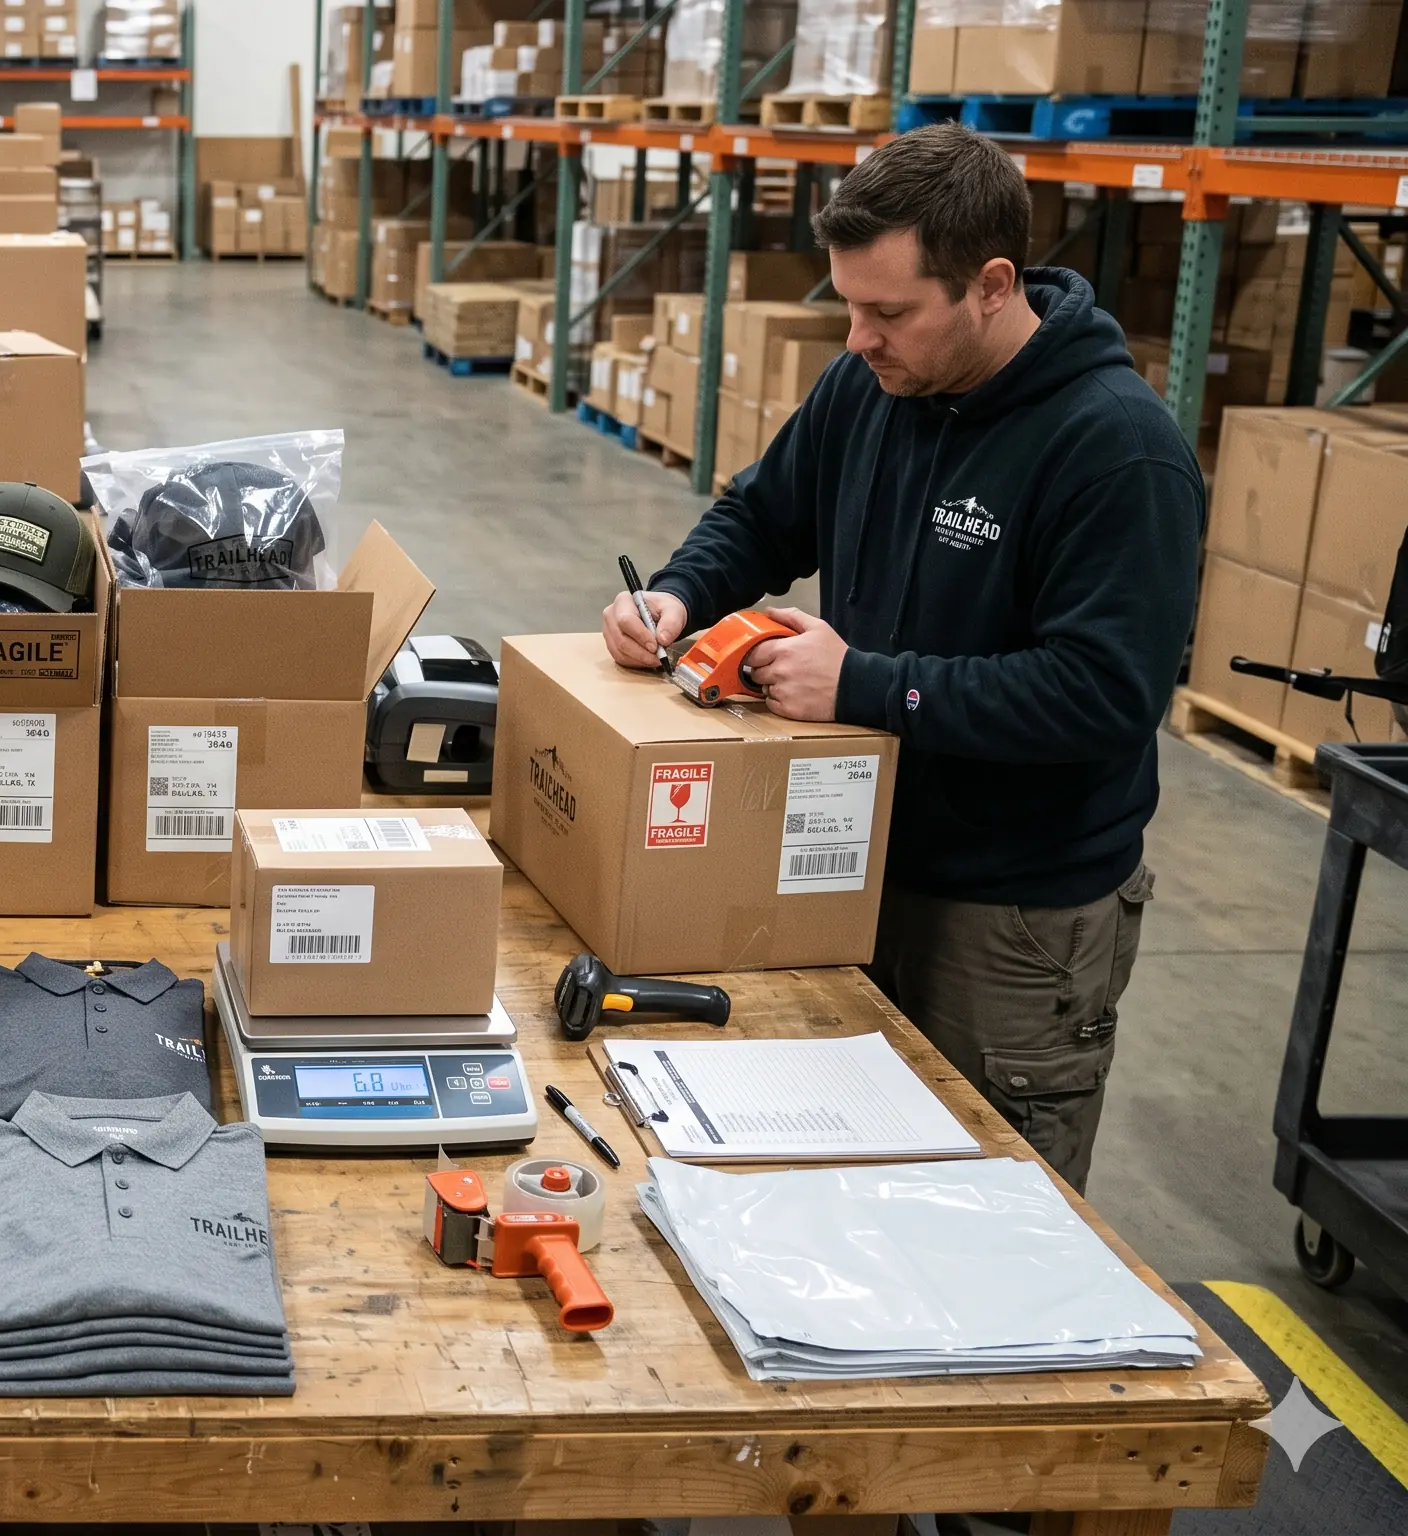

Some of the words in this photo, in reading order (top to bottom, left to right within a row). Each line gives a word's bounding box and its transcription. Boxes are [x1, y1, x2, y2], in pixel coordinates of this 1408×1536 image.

[932, 507, 1001, 541] TRAILHEAD
[656, 768, 708, 780] FRAGILE
[651, 827, 701, 838] FRAGILE
[155, 1032, 206, 1059] TRAIL
